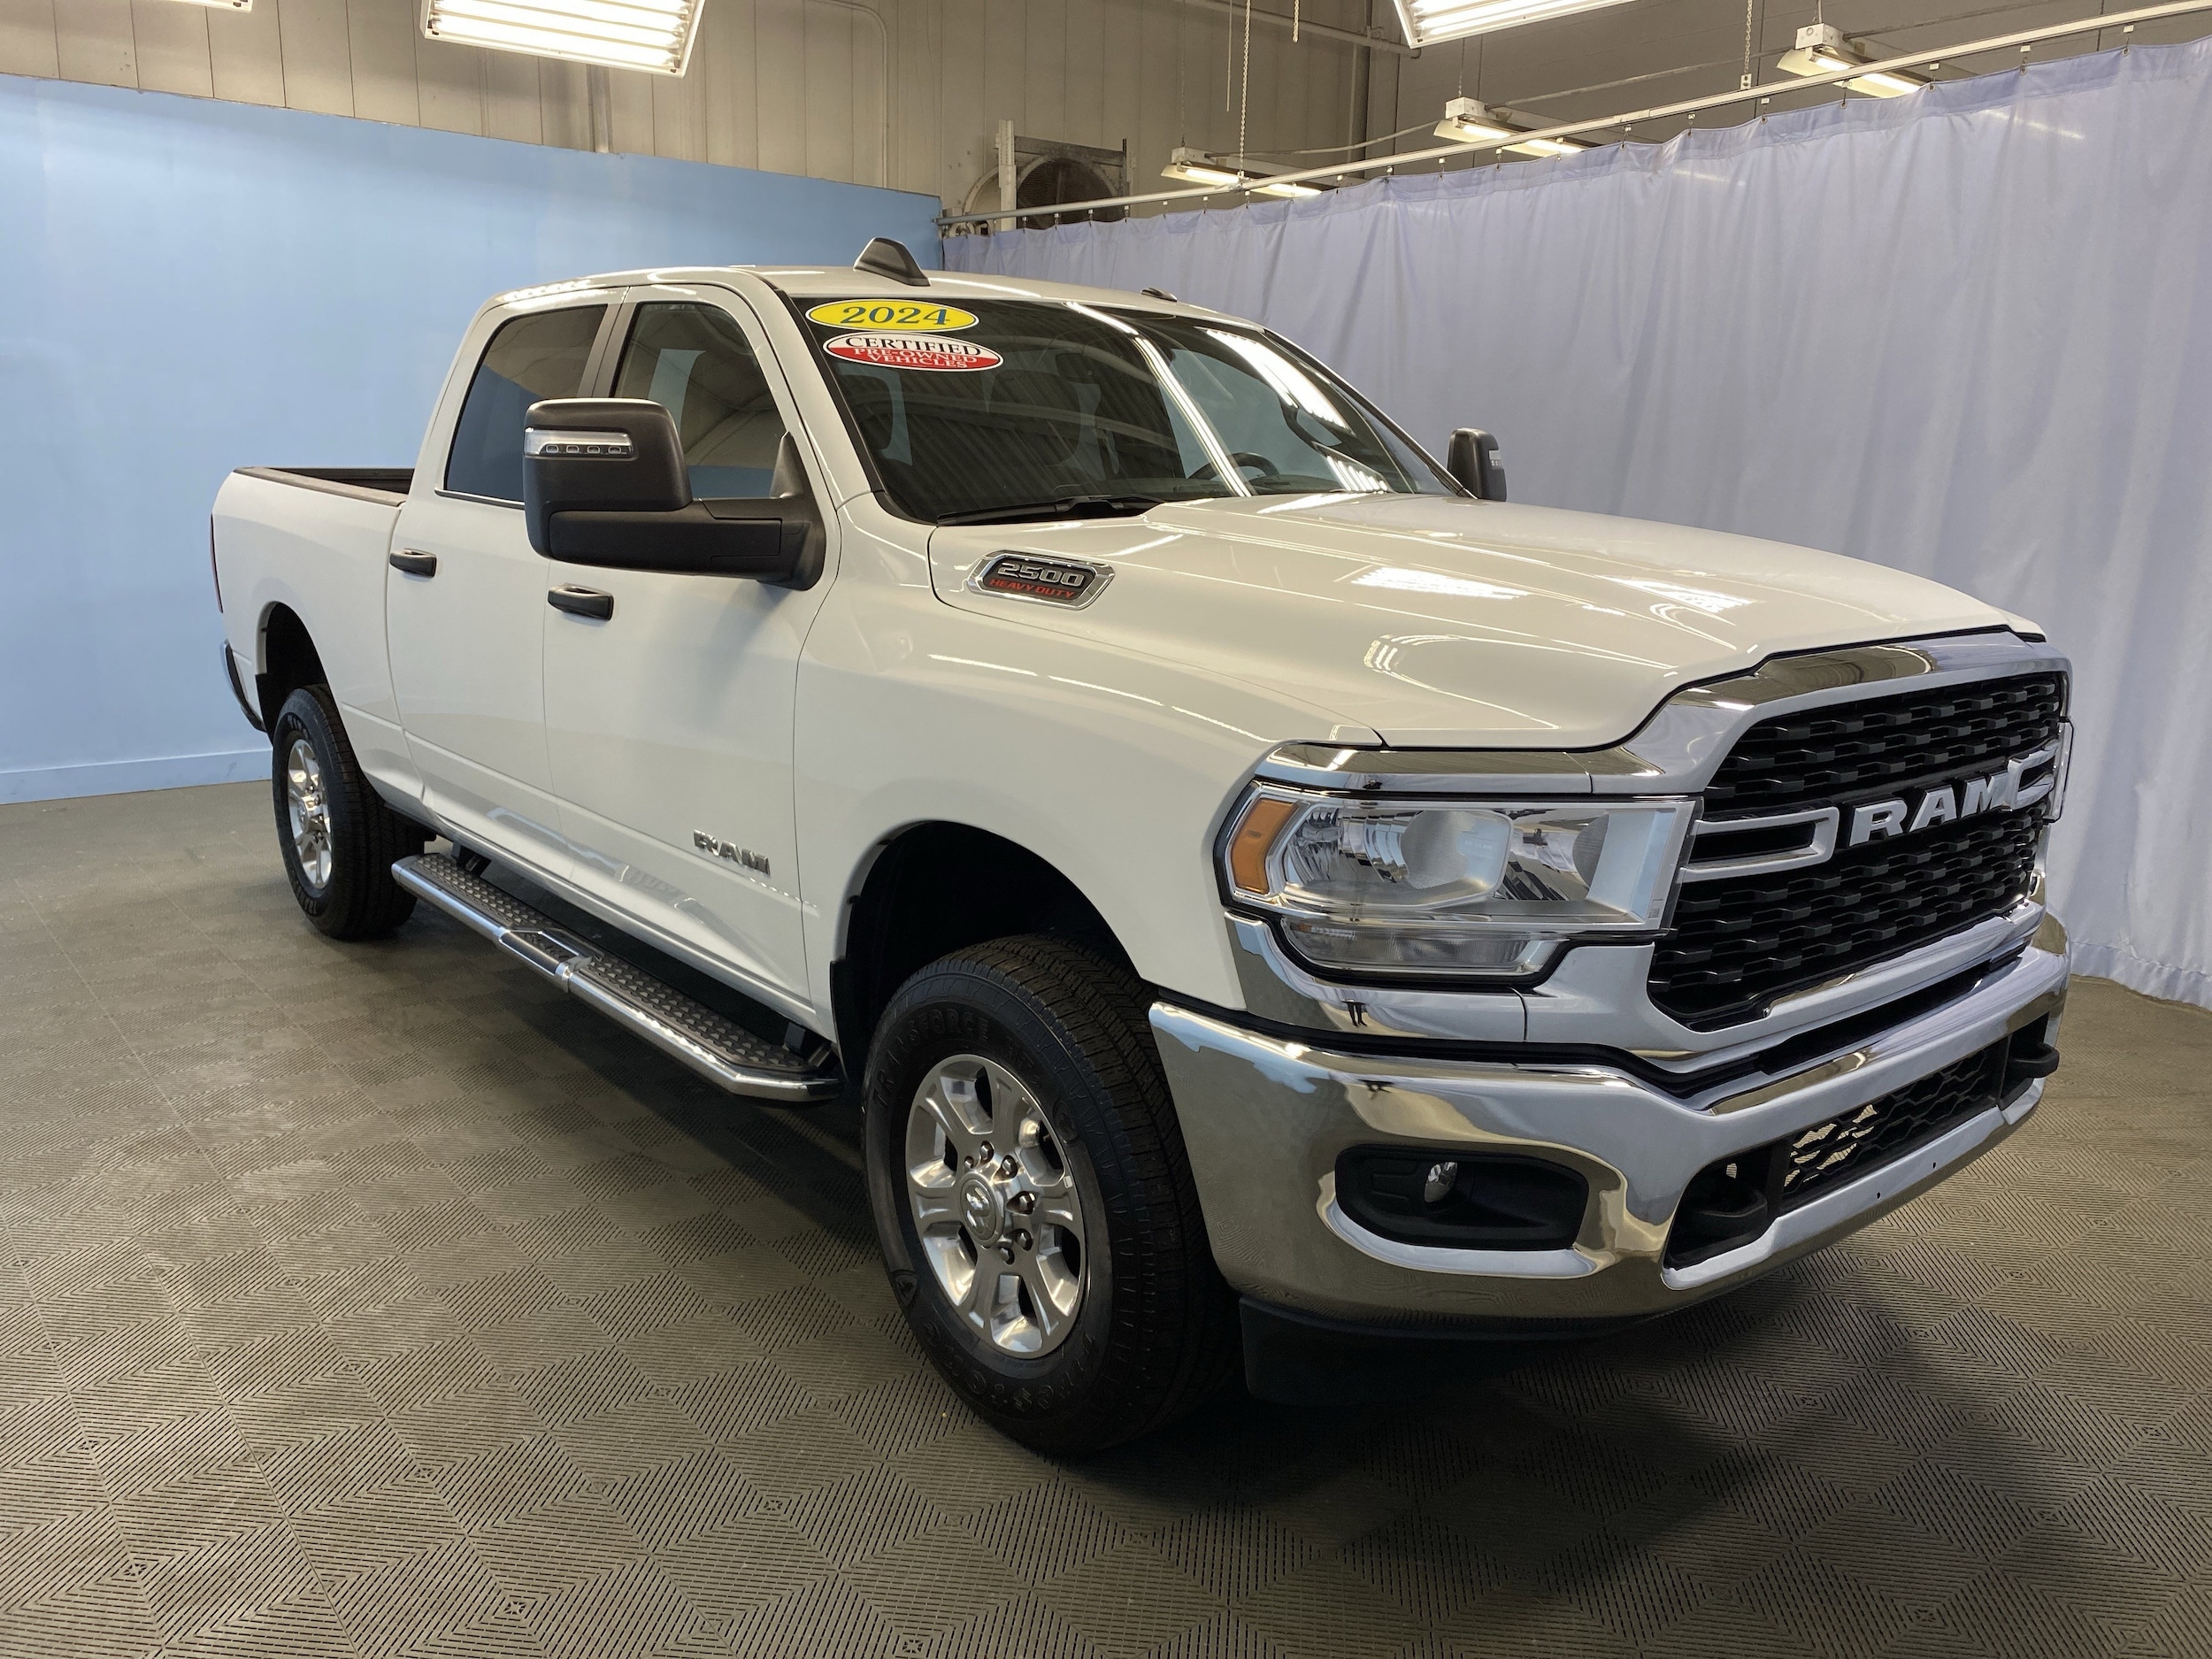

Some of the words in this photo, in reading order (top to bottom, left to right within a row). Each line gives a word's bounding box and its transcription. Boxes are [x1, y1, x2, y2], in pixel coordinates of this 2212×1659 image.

[840, 306, 950, 326] 2024
[845, 337, 981, 356] CERTIFIED
[854, 348, 977, 364] PRE-OWNED
[868, 355, 968, 369] VEHICLES
[997, 562, 1085, 587] 2500
[989, 578, 1033, 592] HEAVY
[1035, 586, 1076, 599] DUTY
[1848, 769, 2010, 847] RAM
[693, 829, 771, 875] RAM
